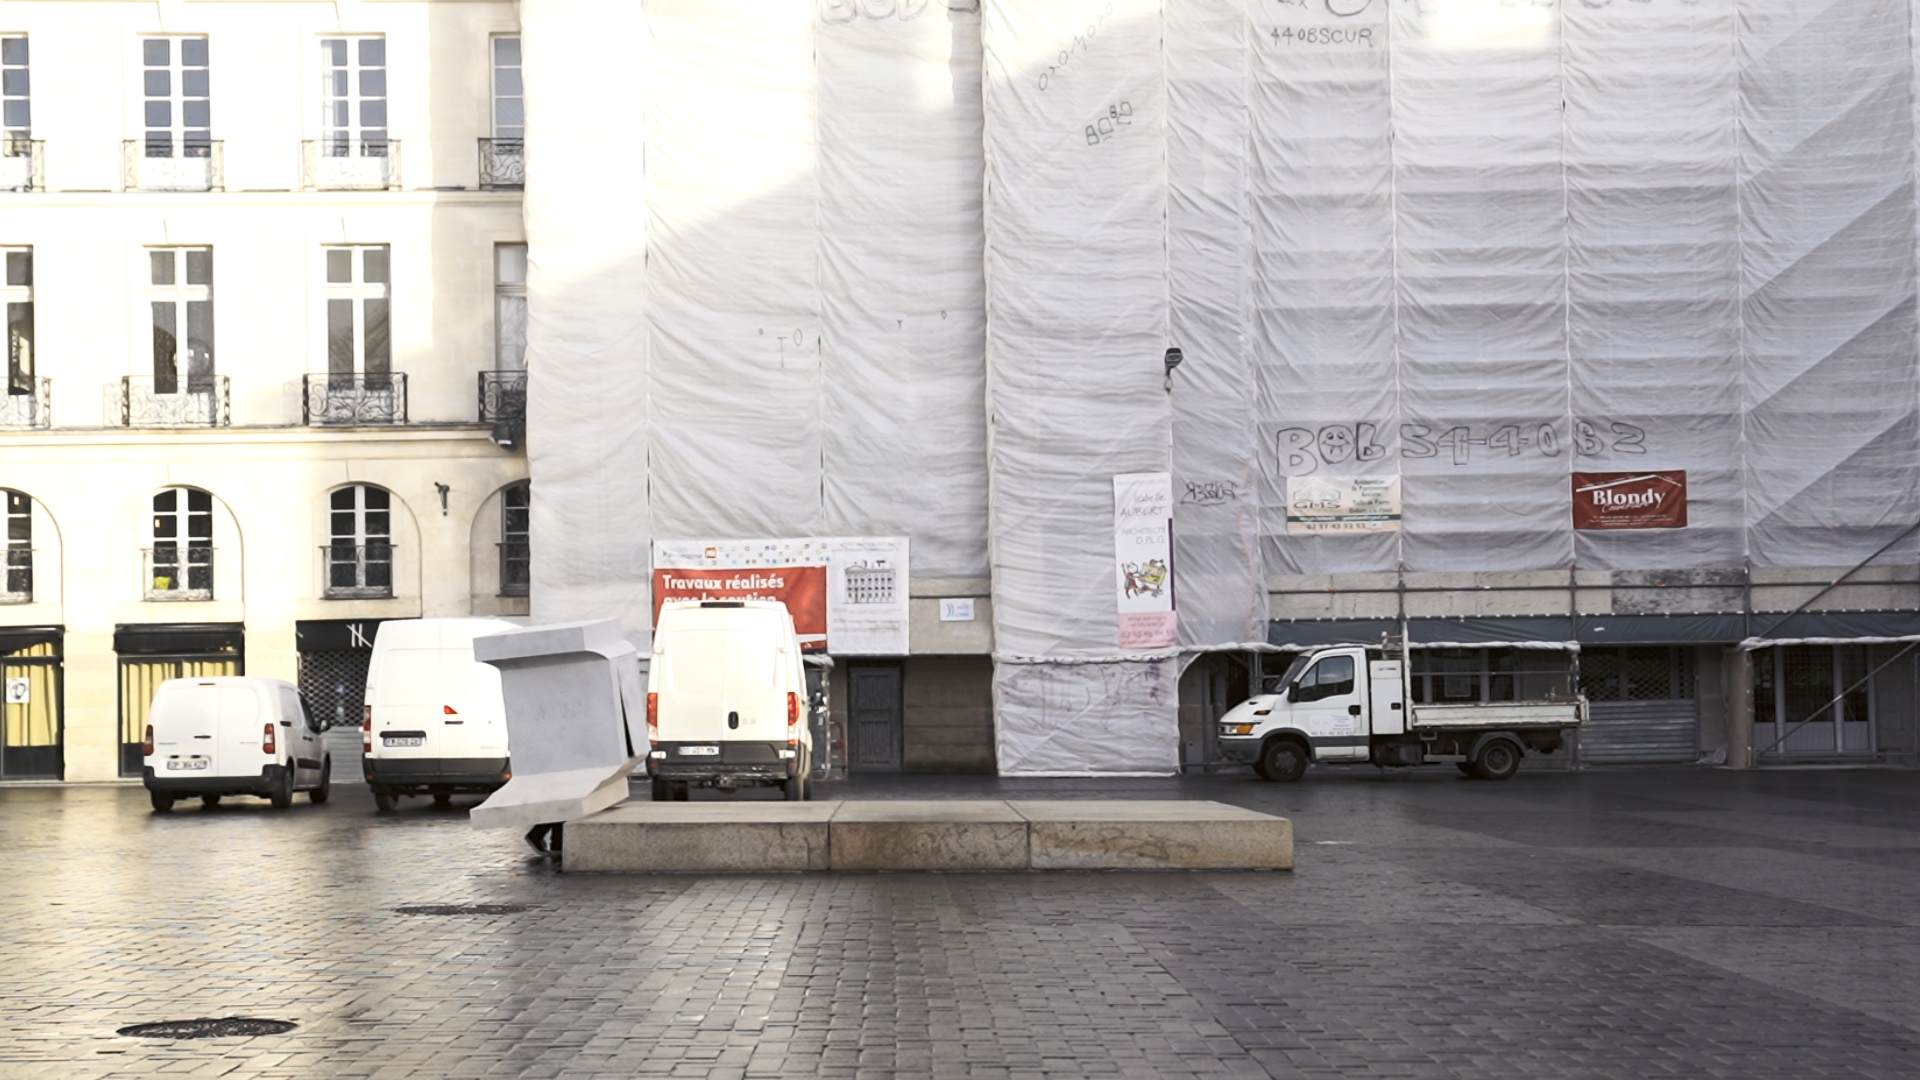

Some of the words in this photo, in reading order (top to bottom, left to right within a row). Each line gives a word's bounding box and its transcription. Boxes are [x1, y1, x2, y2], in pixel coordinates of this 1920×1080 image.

[1293, 501, 1342, 509] GMS
[1593, 488, 1666, 509] Blondy
[1120, 506, 1167, 517] AUBERT
[662, 573, 722, 590] Travaux
[725, 573, 785, 590] réalisés
